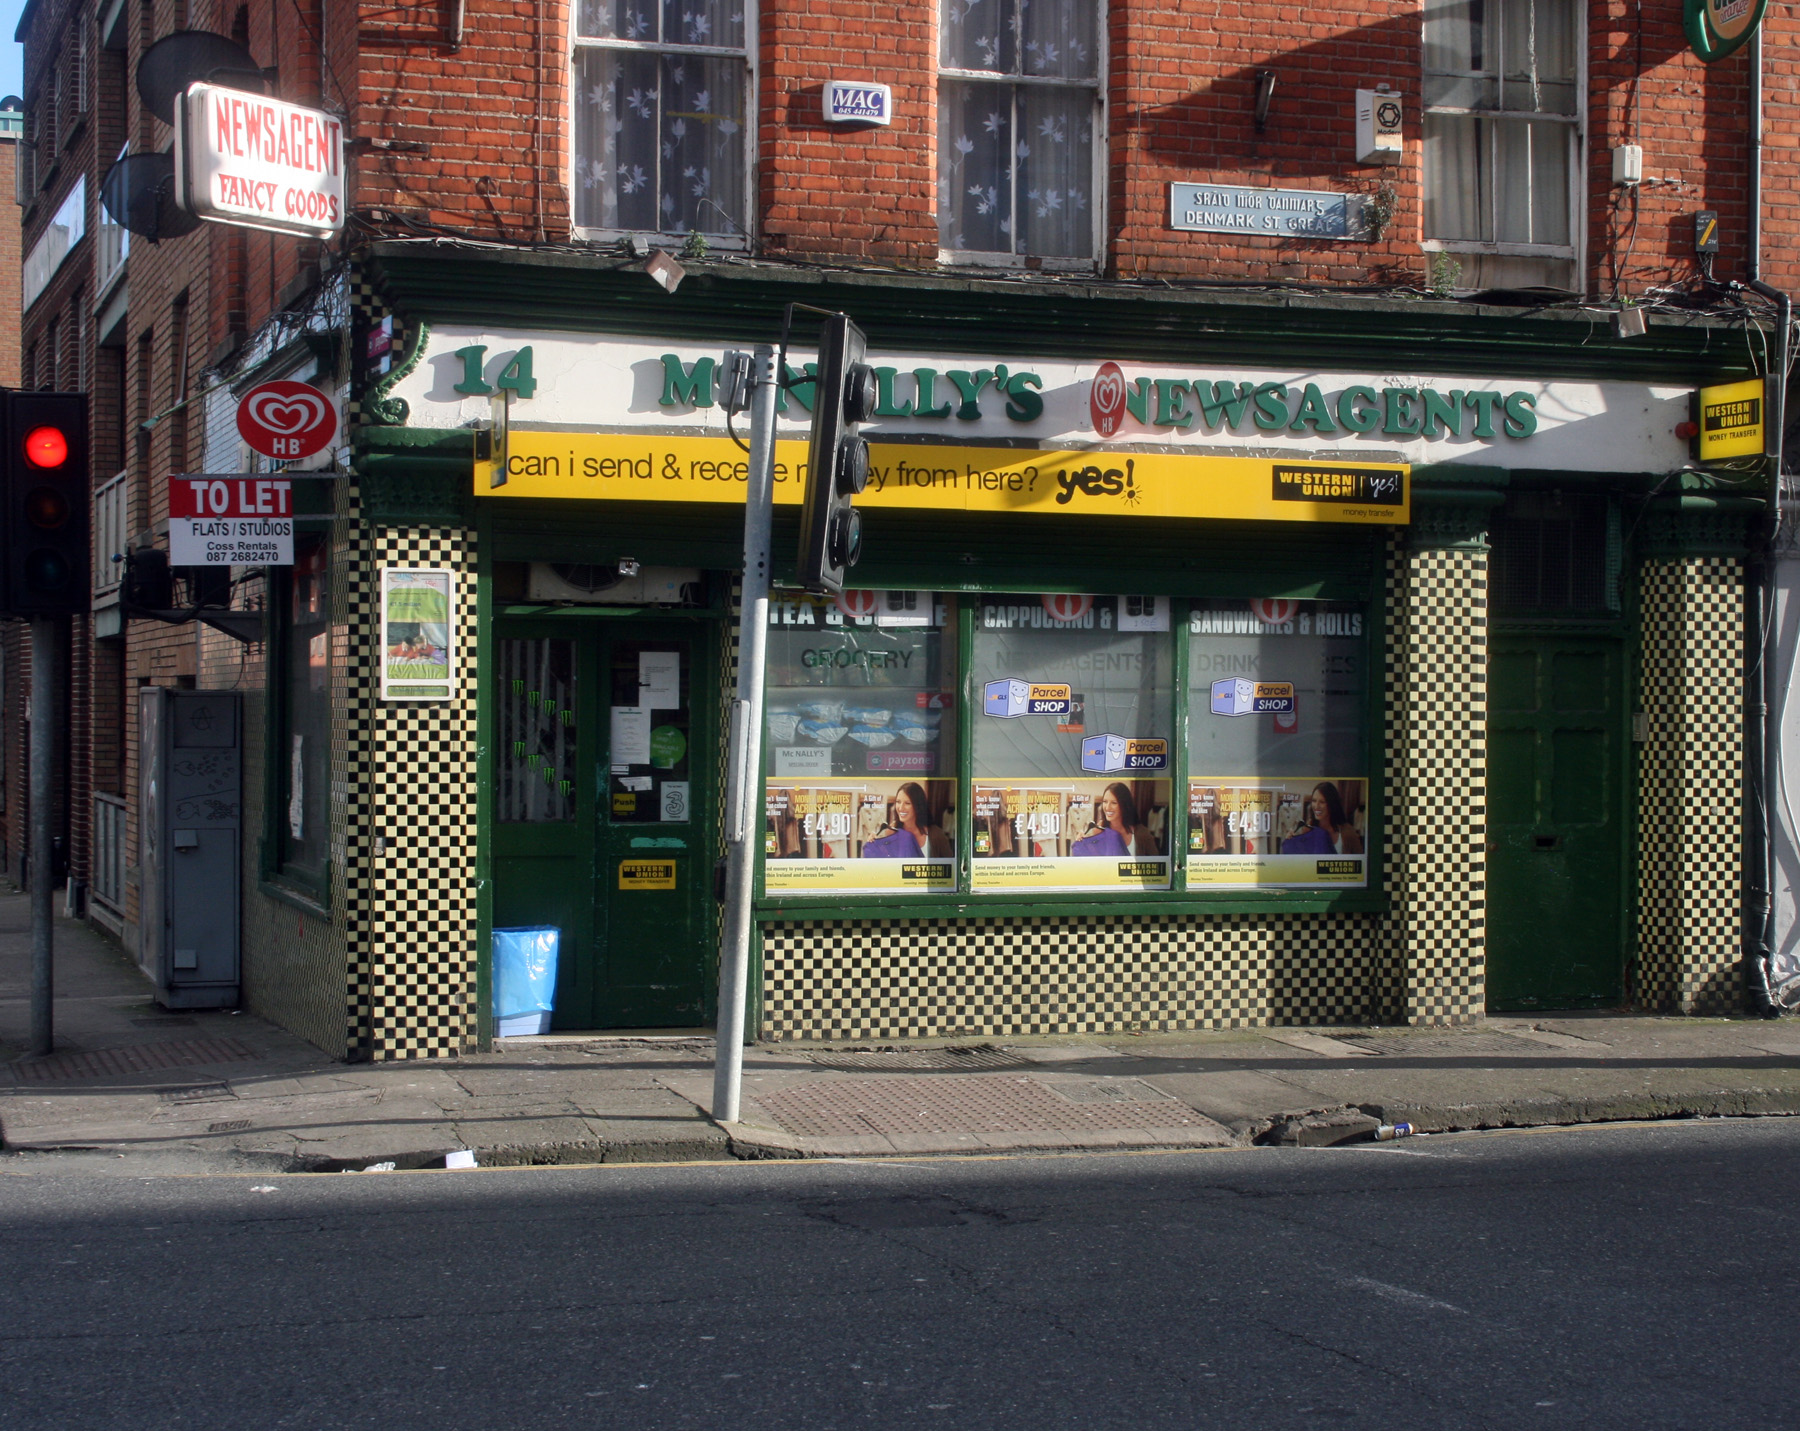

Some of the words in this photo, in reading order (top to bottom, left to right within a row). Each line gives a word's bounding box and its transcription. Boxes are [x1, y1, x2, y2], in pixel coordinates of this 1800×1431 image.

[833, 89, 882, 109] MAC
[853, 108, 878, 116] 441479
[216, 94, 339, 176] NEWSAGENT
[218, 174, 278, 212] FANCY
[285, 187, 338, 223] GOODS
[1186, 211, 1254, 228] DENMARK
[1263, 216, 1280, 229] ST.
[455, 345, 536, 399] 14
[1706, 402, 1750, 418] WESTERN
[1721, 413, 1750, 427] UNION
[1708, 433, 1727, 441] MONEY
[1729, 429, 1757, 440] TRANSFER
[508, 454, 560, 476] can
[569, 451, 574, 477] i
[583, 452, 652, 479] send
[661, 453, 682, 480] &
[690, 460, 788, 482] recee
[897, 461, 957, 488] from
[967, 464, 1038, 492] here?
[1280, 472, 1352, 485] WESTERN
[1055, 459, 1138, 504] yes!
[1370, 475, 1398, 498] yes!
[190, 481, 229, 514] TO
[239, 481, 291, 514] LET
[1302, 485, 1352, 496] UNION
[1343, 510, 1367, 518] money
[1368, 509, 1394, 517] transfer
[192, 522, 230, 536] FLATS
[239, 522, 291, 536] STUDIOS
[207, 541, 234, 550] Coss
[238, 541, 277, 550] Rentals
[207, 552, 226, 562] 087
[231, 552, 278, 561] 2682470
[769, 602, 815, 625] TEA
[1100, 608, 1113, 630] &
[1299, 612, 1311, 635] &
[1315, 613, 1362, 636] ROLLS
[801, 649, 913, 668] GROCERY
[1032, 687, 1067, 697] Parcel
[1256, 685, 1291, 696] Parcel
[1034, 702, 1065, 712] SHOP
[1258, 700, 1288, 710] SHOP
[1128, 742, 1164, 752] Parcel
[888, 756, 931, 767] payzone
[1130, 756, 1162, 767] SHOP
